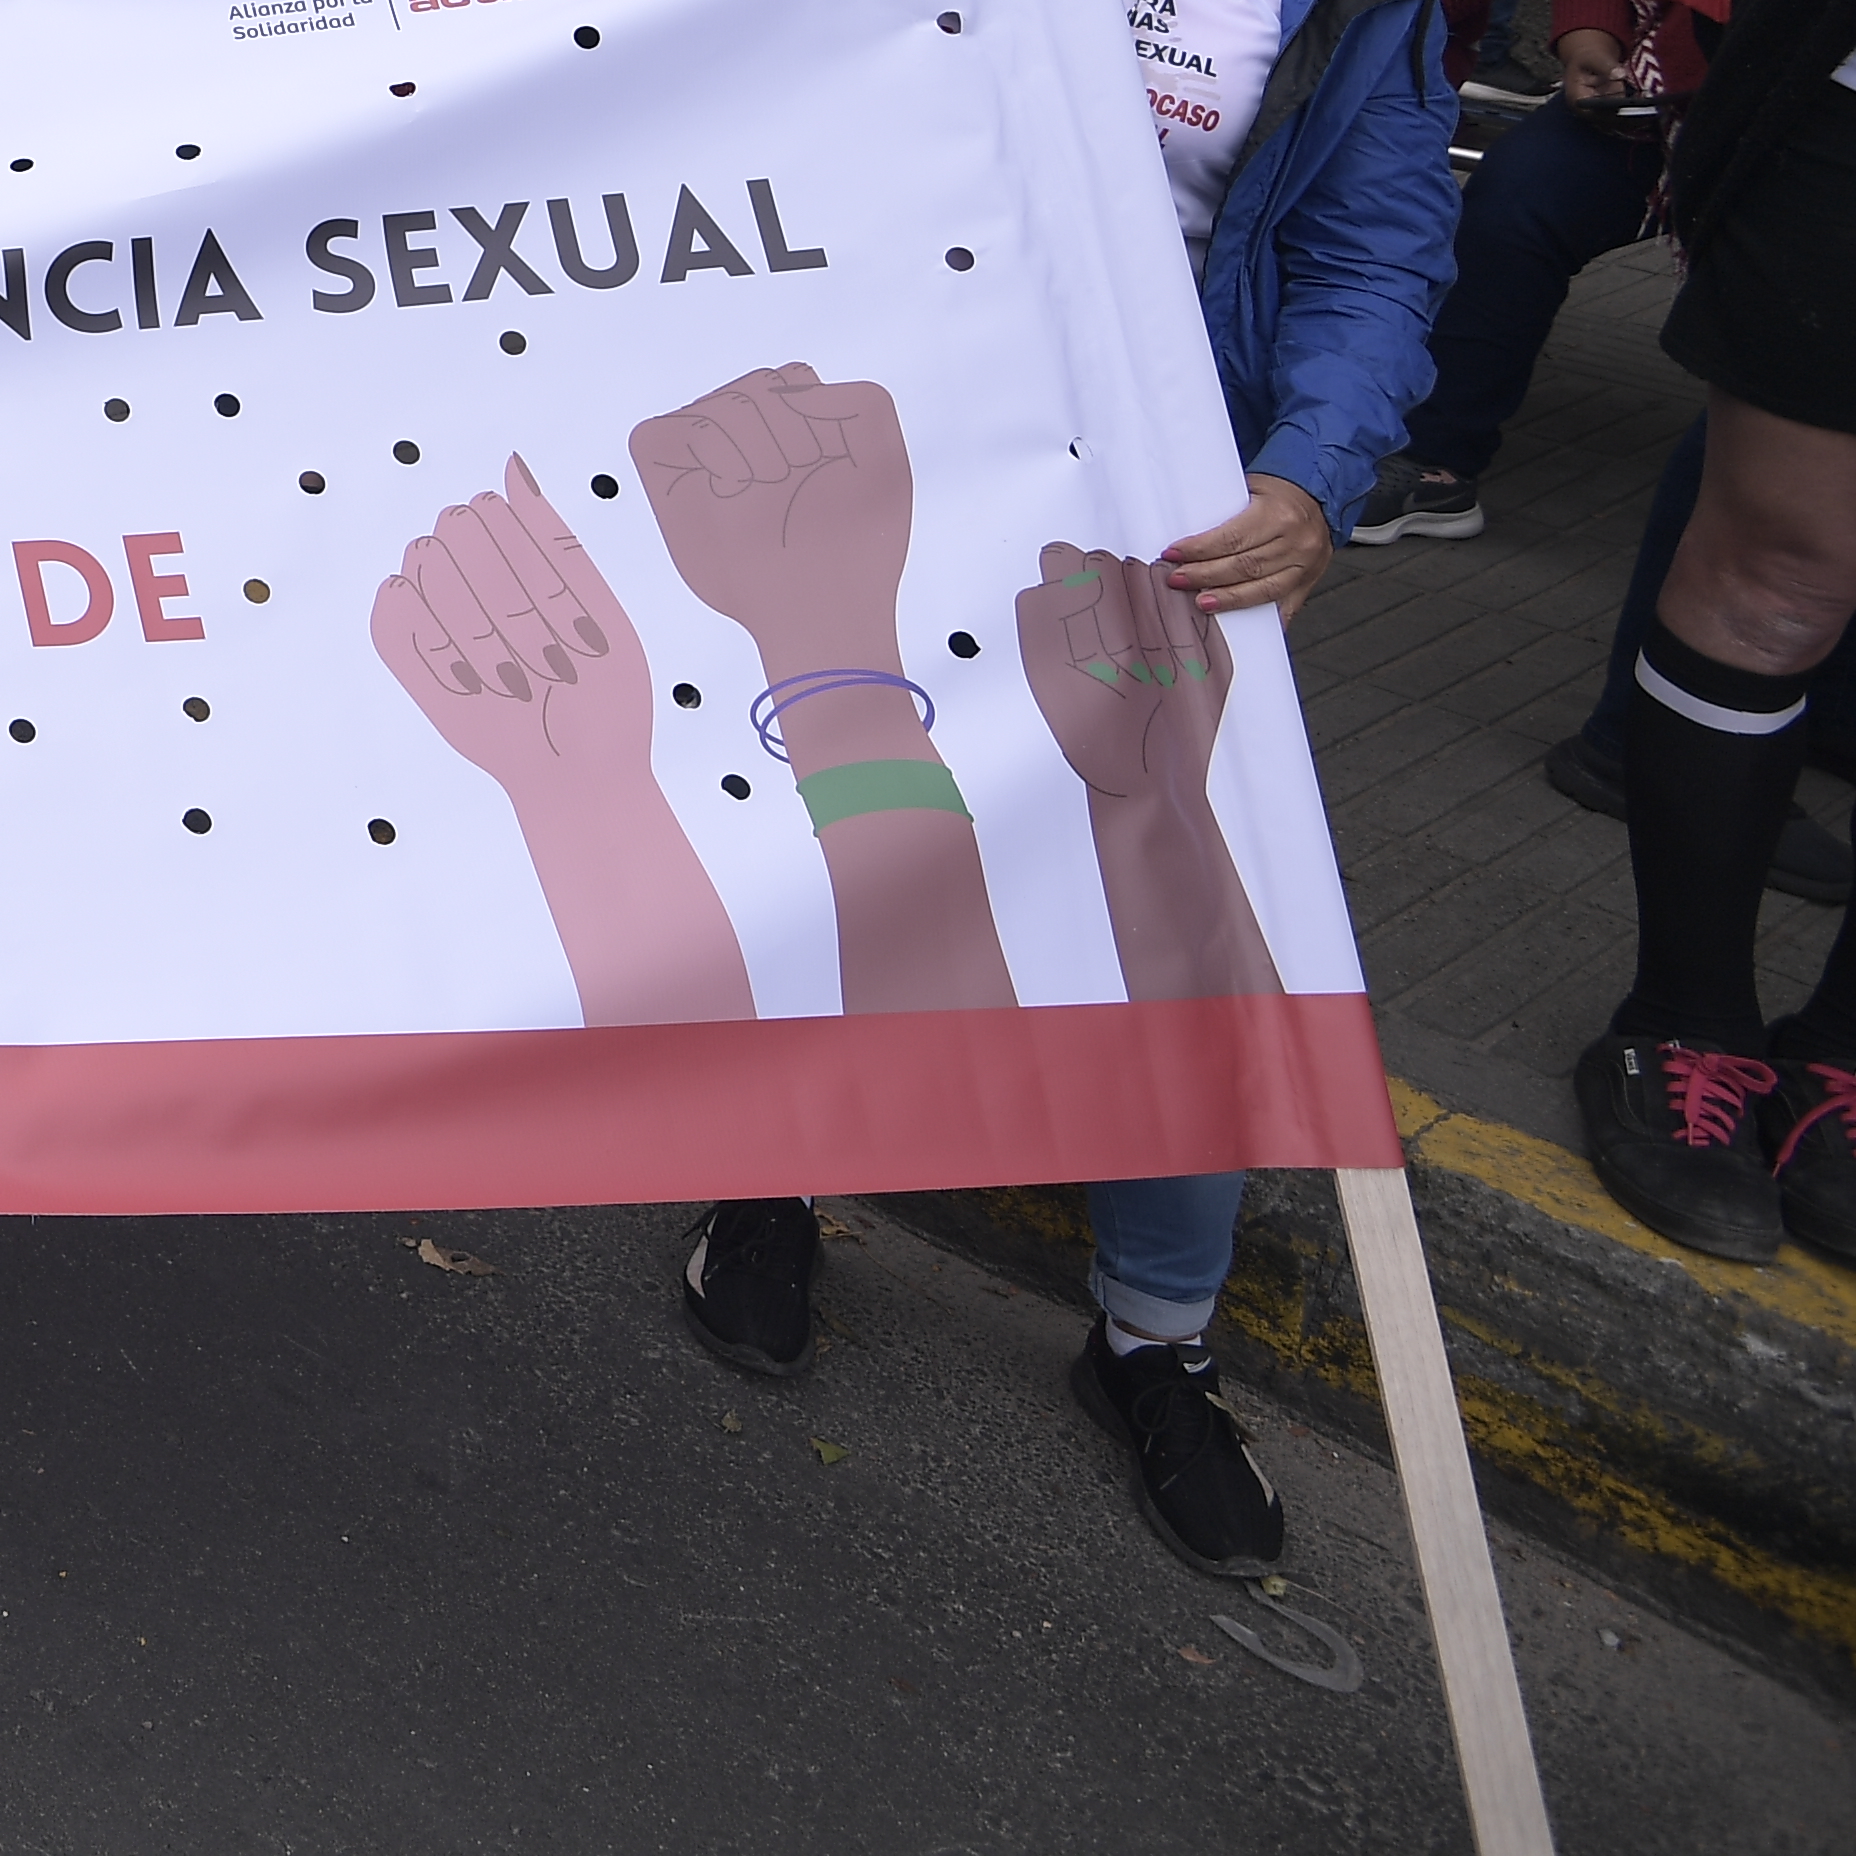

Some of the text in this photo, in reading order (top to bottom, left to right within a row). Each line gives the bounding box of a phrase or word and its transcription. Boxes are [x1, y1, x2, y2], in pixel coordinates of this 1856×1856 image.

[232, 12, 356, 41] Solidaridad
[307, 176, 830, 316] SEXUAL
[11, 530, 207, 648] DE
